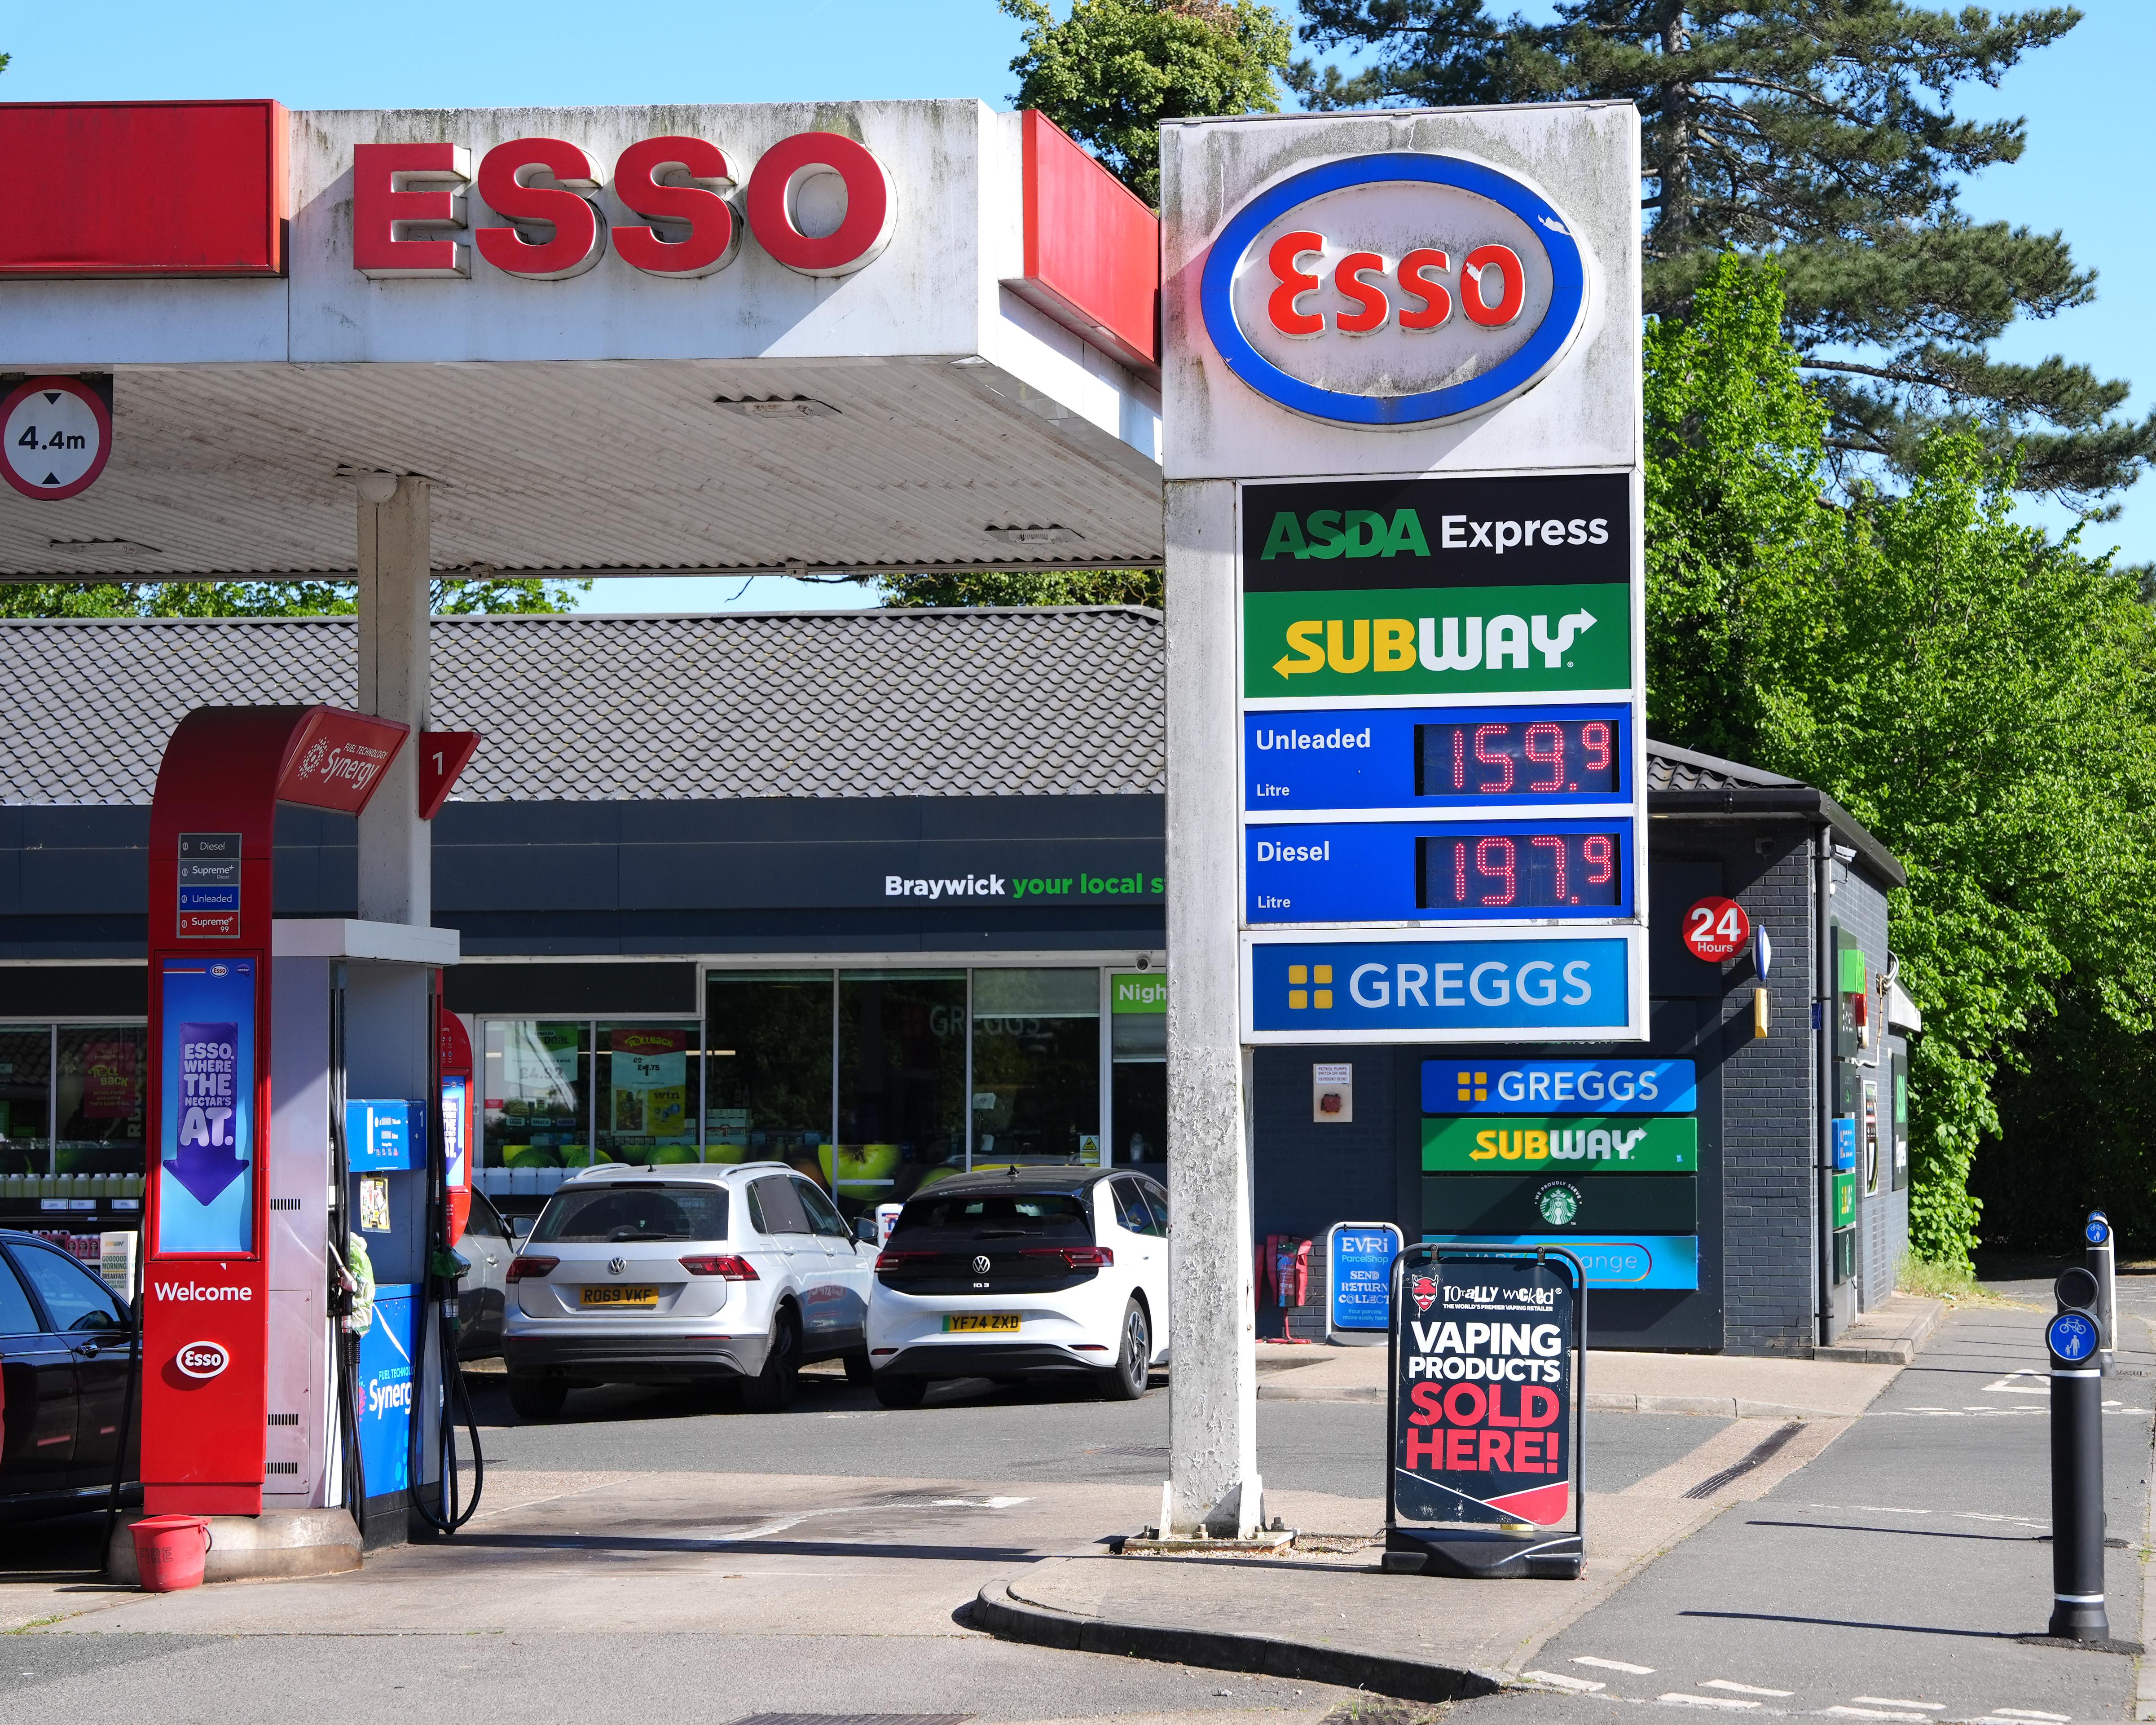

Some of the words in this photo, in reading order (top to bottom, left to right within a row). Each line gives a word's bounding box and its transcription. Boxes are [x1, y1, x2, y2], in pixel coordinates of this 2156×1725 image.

[353, 132, 894, 278] ESSO
[1268, 230, 1525, 338] Esso
[18, 425, 85, 451] 4.4m
[1260, 508, 1430, 560] ASDA
[1442, 515, 1608, 554] Express
[1272, 608, 1597, 679] SUBWAY
[343, 743, 355, 753] FUEL
[356, 745, 388, 759] TECHNOLOGY
[1256, 728, 1371, 750] Unleaded
[1454, 723, 1610, 793] 159.9
[320, 748, 380, 790] Synergy
[432, 751, 443, 775] 1
[1257, 784, 1290, 797] Litre
[200, 842, 225, 850] Diesel
[1257, 842, 1330, 862] Diesel
[1455, 836, 1612, 906] 197.9
[885, 874, 1005, 900] Braywick
[1012, 876, 1073, 899] your
[1080, 873, 1143, 894] local
[192, 894, 232, 903] Unleaded
[1257, 896, 1291, 909] Litre
[1690, 907, 1742, 942] 24
[1697, 942, 1734, 953] Hours
[1119, 984, 1166, 1003] Nigh
[1349, 960, 1593, 1008] GREGGS
[929, 1005, 1040, 1036] GRGGS
[185, 1042, 234, 1060] ESSO.
[184, 1060, 232, 1073] WHERE
[637, 1064, 660, 1076] £1.75
[183, 1073, 232, 1096] THE
[1498, 1070, 1659, 1102] GREGGS
[185, 1096, 232, 1107] NECTAR'S
[653, 1091, 680, 1099] win
[180, 1107, 234, 1147] AT.
[1468, 1127, 1647, 1161] SUBWAY
[1535, 1191, 1542, 1200] WE
[1540, 1181, 1566, 1191] PROUDLY
[1567, 1184, 1582, 1199] SERVE
[1342, 1237, 1389, 1253] EVRi
[1342, 1255, 1389, 1265] ParcelShop
[1350, 1271, 1380, 1280] SEND
[154, 1281, 252, 1302] Welcome
[584, 1289, 621, 1302] RO69
[625, 1289, 652, 1301] VKF
[1341, 1283, 1389, 1292] RETURN
[1443, 1285, 1499, 1303] TOTaLLY
[1503, 1287, 1554, 1305] wicked
[1338, 1294, 1389, 1304] COLLECT
[952, 1316, 987, 1329] YF74
[991, 1315, 1019, 1328] ZXD
[1410, 1321, 1562, 1357] VAPING
[185, 1350, 222, 1367] Esso
[379, 1370, 390, 1381] FUEL
[391, 1366, 414, 1379] TECHNOLO
[1409, 1356, 1561, 1383] PRODUCTS
[369, 1379, 413, 1420] Synerg
[1408, 1381, 1560, 1429] SOLD
[1405, 1427, 1559, 1474] HERE!
